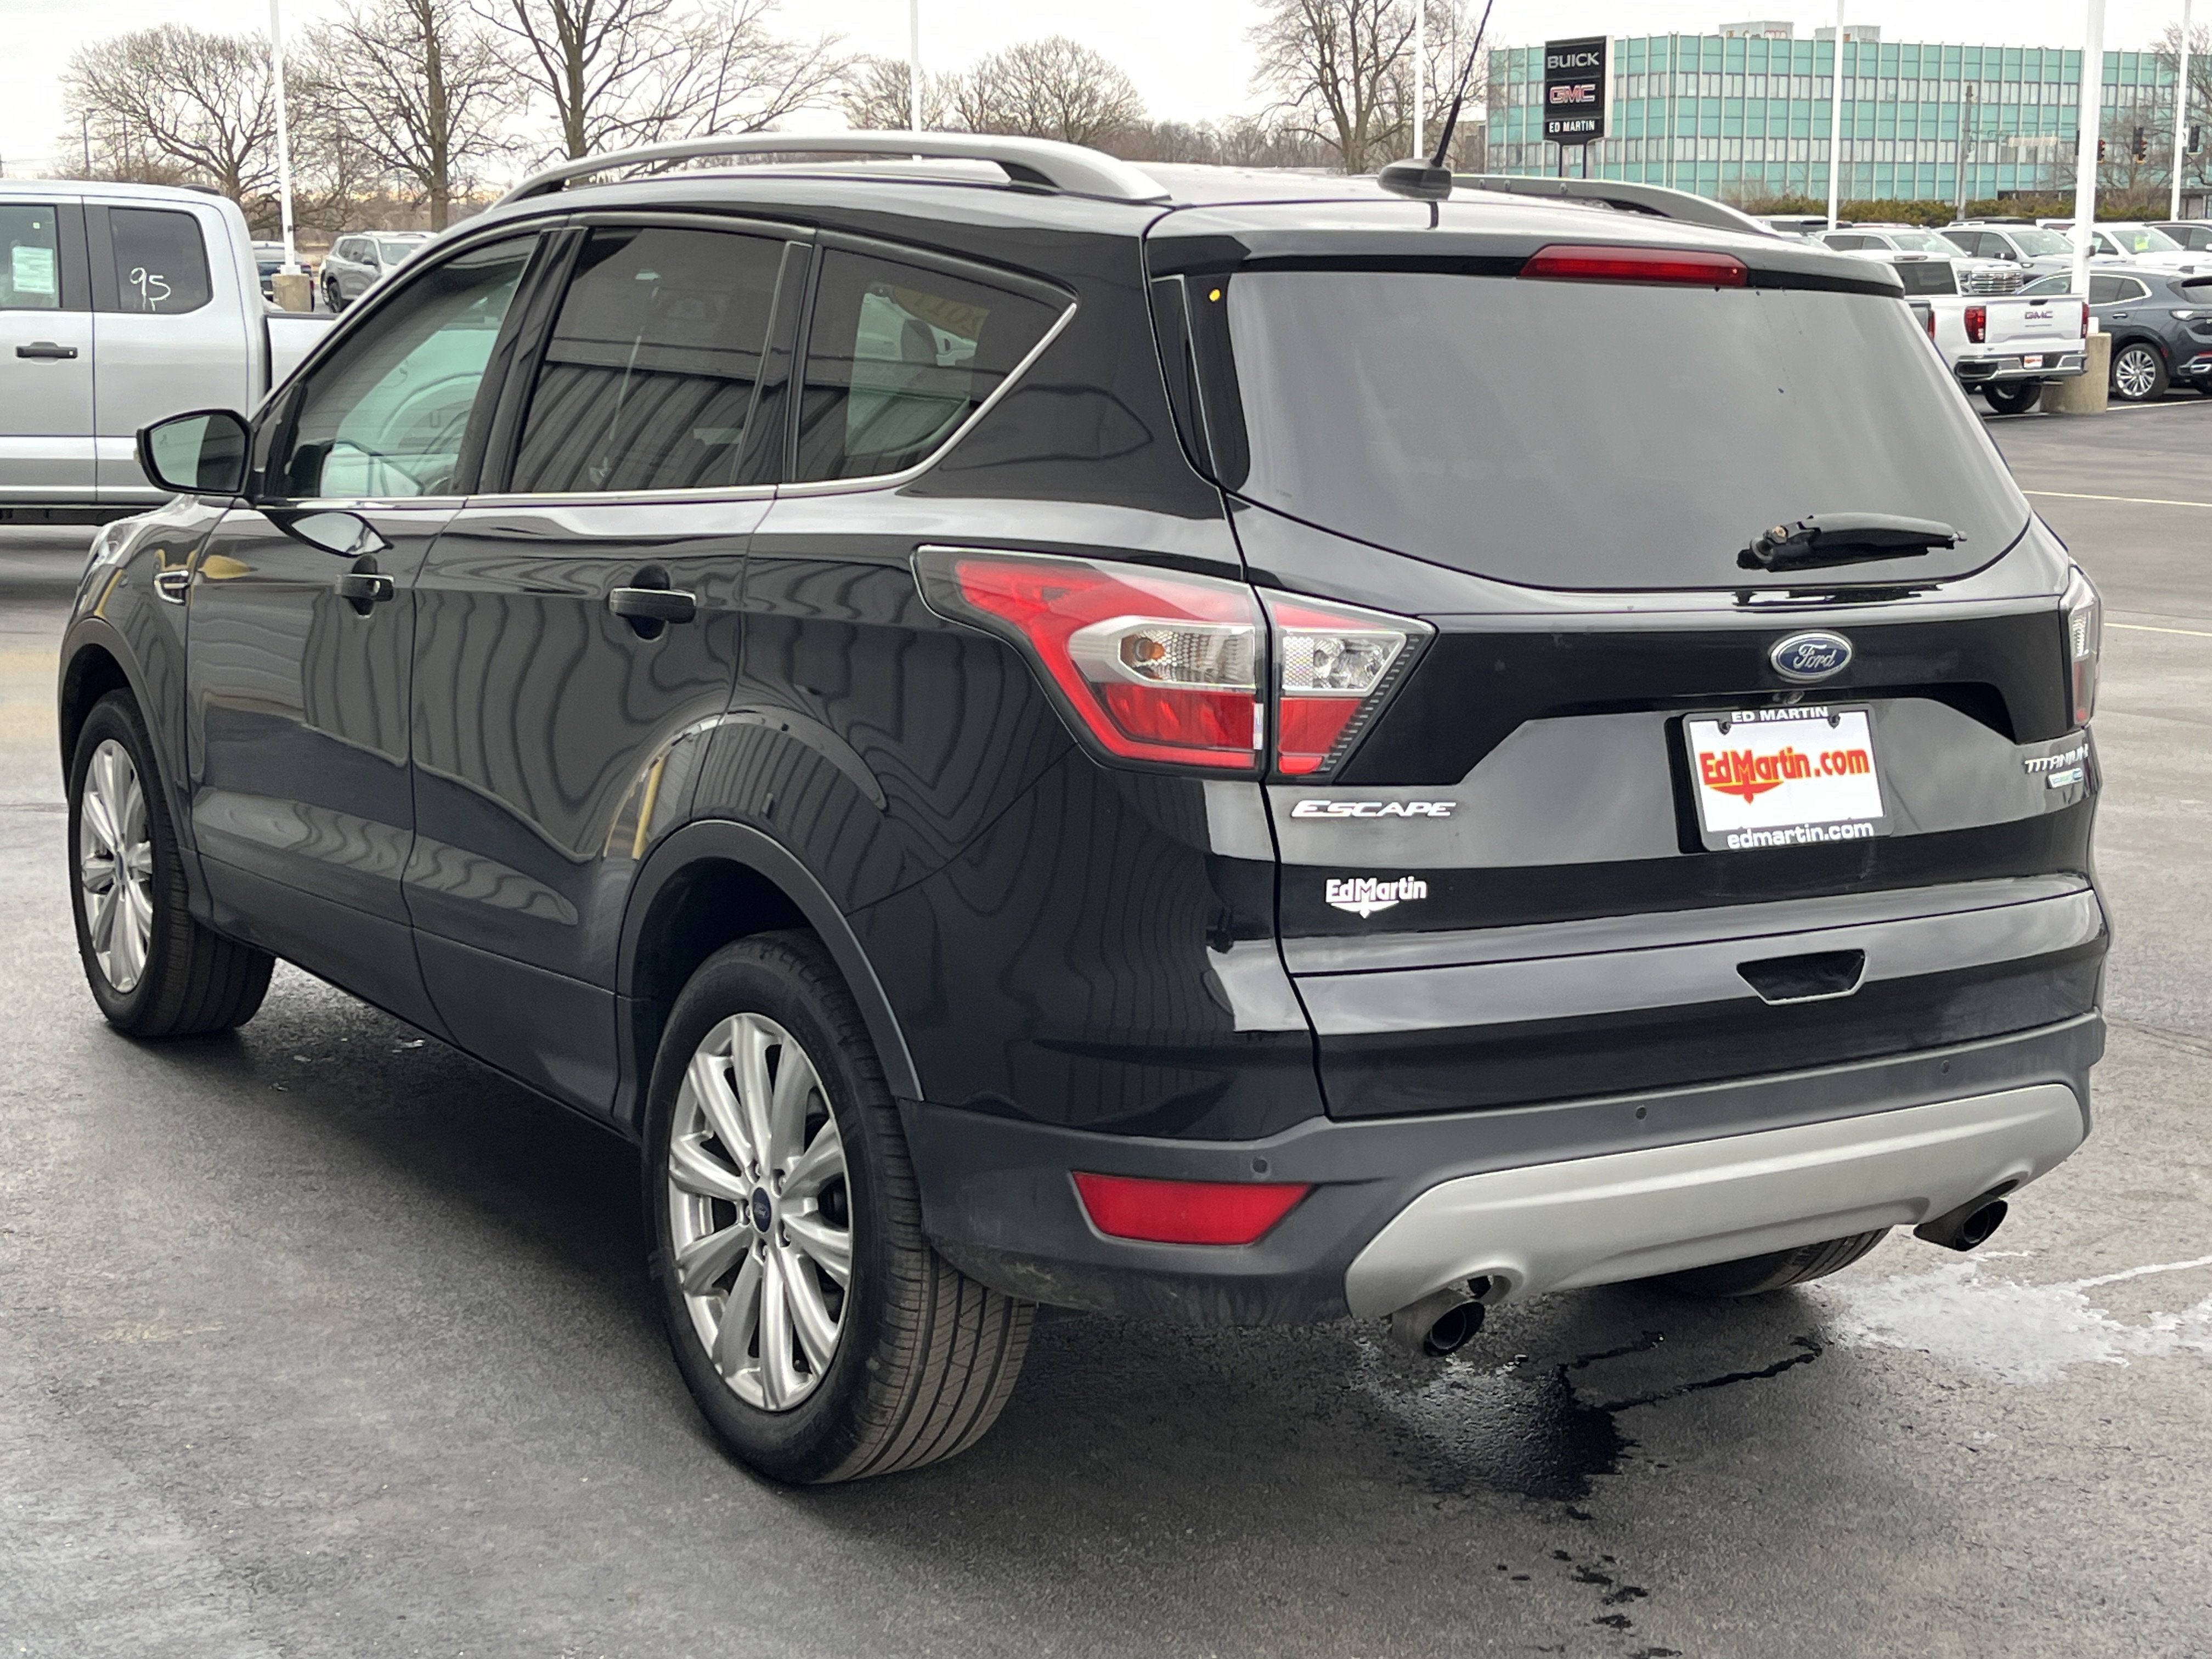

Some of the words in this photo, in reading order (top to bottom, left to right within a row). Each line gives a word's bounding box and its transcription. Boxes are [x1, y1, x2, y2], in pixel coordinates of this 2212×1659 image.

[1547, 52, 1599, 69] BUICK
[1550, 84, 1595, 104] GMC
[1549, 121, 1560, 133] ED
[1562, 120, 1595, 132] MARTIN
[129, 267, 171, 309] 95
[2024, 311, 2053, 319] GMC
[1793, 644, 1837, 669] Ford
[1731, 710, 1756, 723] ED
[1759, 706, 1829, 721] MARTIN
[1700, 746, 1870, 786] EdMartin.com
[2024, 743, 2089, 774] TITANIUM
[1291, 800, 1457, 817] ESCAPE
[1727, 822, 1874, 849] edmartin.com
[1325, 876, 1427, 903] EdMartin
